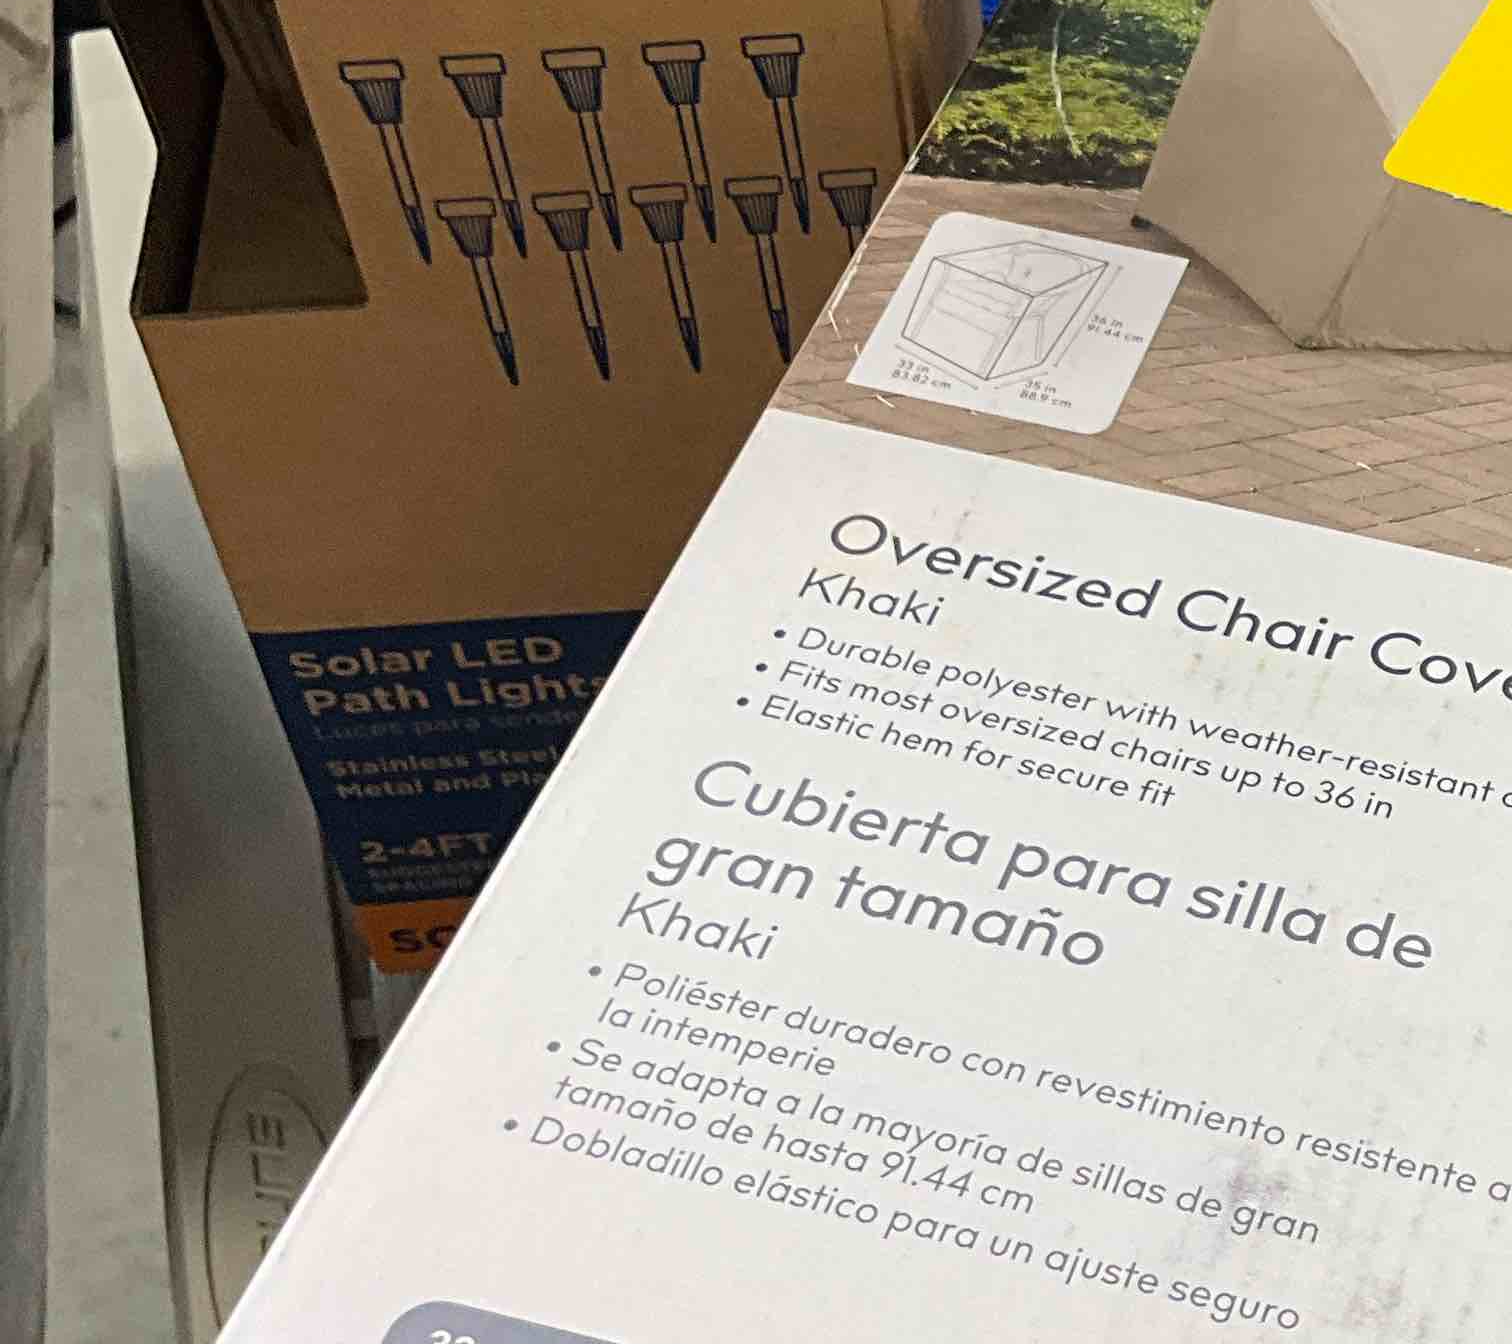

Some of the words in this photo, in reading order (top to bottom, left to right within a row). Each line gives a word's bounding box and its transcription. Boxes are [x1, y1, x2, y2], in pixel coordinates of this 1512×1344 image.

[797, 566, 945, 627] Khaki
[830, 513, 1164, 620] Oversized
[1176, 589, 1355, 661] Chair
[288, 646, 433, 679] Solar
[451, 635, 566, 670] LED
[304, 684, 430, 718] Path
[797, 626, 932, 676] Durable
[935, 664, 1099, 712] polyester
[1105, 699, 1178, 732] with
[1188, 717, 1496, 803] weather-resistant
[759, 693, 875, 740] Elastic
[880, 720, 954, 758] hem
[961, 739, 1014, 770] for
[1015, 758, 1129, 798] secure
[1138, 779, 1176, 808] fit
[778, 659, 843, 694] Fits
[847, 681, 935, 713] most
[939, 703, 1106, 752] oversized
[1109, 736, 1213, 777] chairs
[1219, 764, 1262, 794] up
[1271, 771, 1305, 798] to
[1313, 779, 1356, 809] 36
[1363, 791, 1393, 820] in
[360, 832, 493, 864] 2-4FT
[645, 837, 814, 901] gran
[833, 864, 1105, 966] tamaño
[693, 760, 991, 866] Cubierta
[995, 841, 1173, 909] para
[1184, 879, 1327, 945] silla
[1345, 911, 1433, 969] de
[616, 891, 779, 960] Khaki
[597, 996, 635, 1029] la
[639, 1007, 836, 1077] intemperie
[613, 962, 780, 1023] Poliéster
[783, 1005, 952, 1065] duradero
[961, 1052, 1027, 1084] con
[1035, 1069, 1286, 1146] revestimiento
[1295, 1132, 1478, 1194] resistente
[554, 1074, 698, 1131] tamaño
[706, 1112, 754, 1145] de
[761, 1122, 870, 1173] hasta
[879, 1151, 975, 1198] 91.44
[980, 1184, 1034, 1215] cm
[571, 1038, 623, 1073] Se
[631, 1059, 769, 1108] adapta
[808, 1092, 845, 1126] la
[850, 1111, 1008, 1166] mayoría
[1015, 1146, 1064, 1179] de
[1071, 1162, 1168, 1205] sillas
[1175, 1184, 1223, 1218] de
[1229, 1195, 1320, 1245] gran
[529, 1115, 724, 1187] Dobladillo
[733, 1169, 879, 1224] elástico
[881, 1209, 981, 1250] para
[989, 1235, 1034, 1264] un
[1044, 1247, 1160, 1295] ajuste
[1167, 1280, 1300, 1330] seguro
